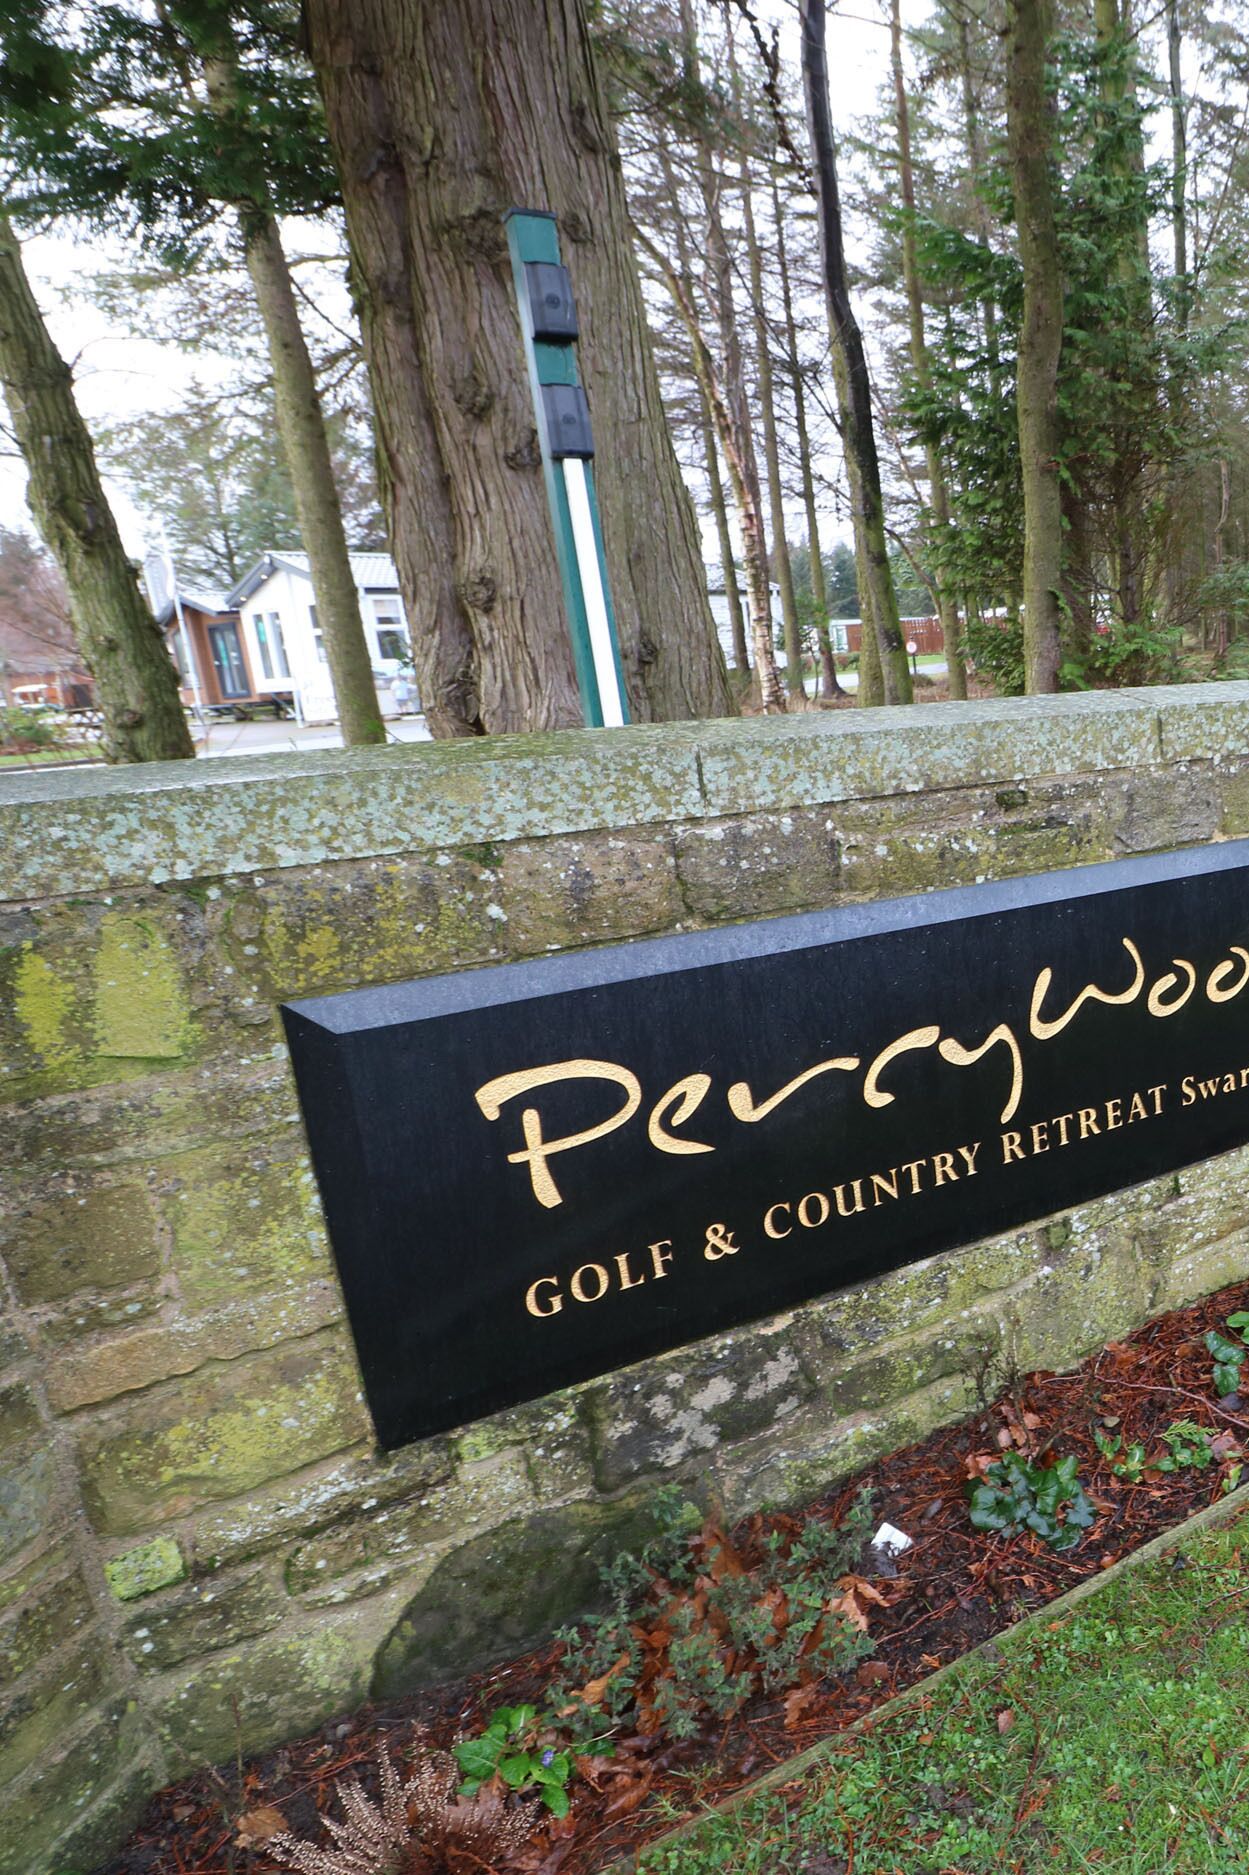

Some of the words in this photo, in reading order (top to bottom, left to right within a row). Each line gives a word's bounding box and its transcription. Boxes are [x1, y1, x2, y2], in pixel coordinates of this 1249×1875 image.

[525, 1240, 673, 1317] GOLF
[703, 1222, 739, 1261] &
[763, 1142, 982, 1240] COUNTRY
[1000, 1084, 1168, 1164] RETREAT
